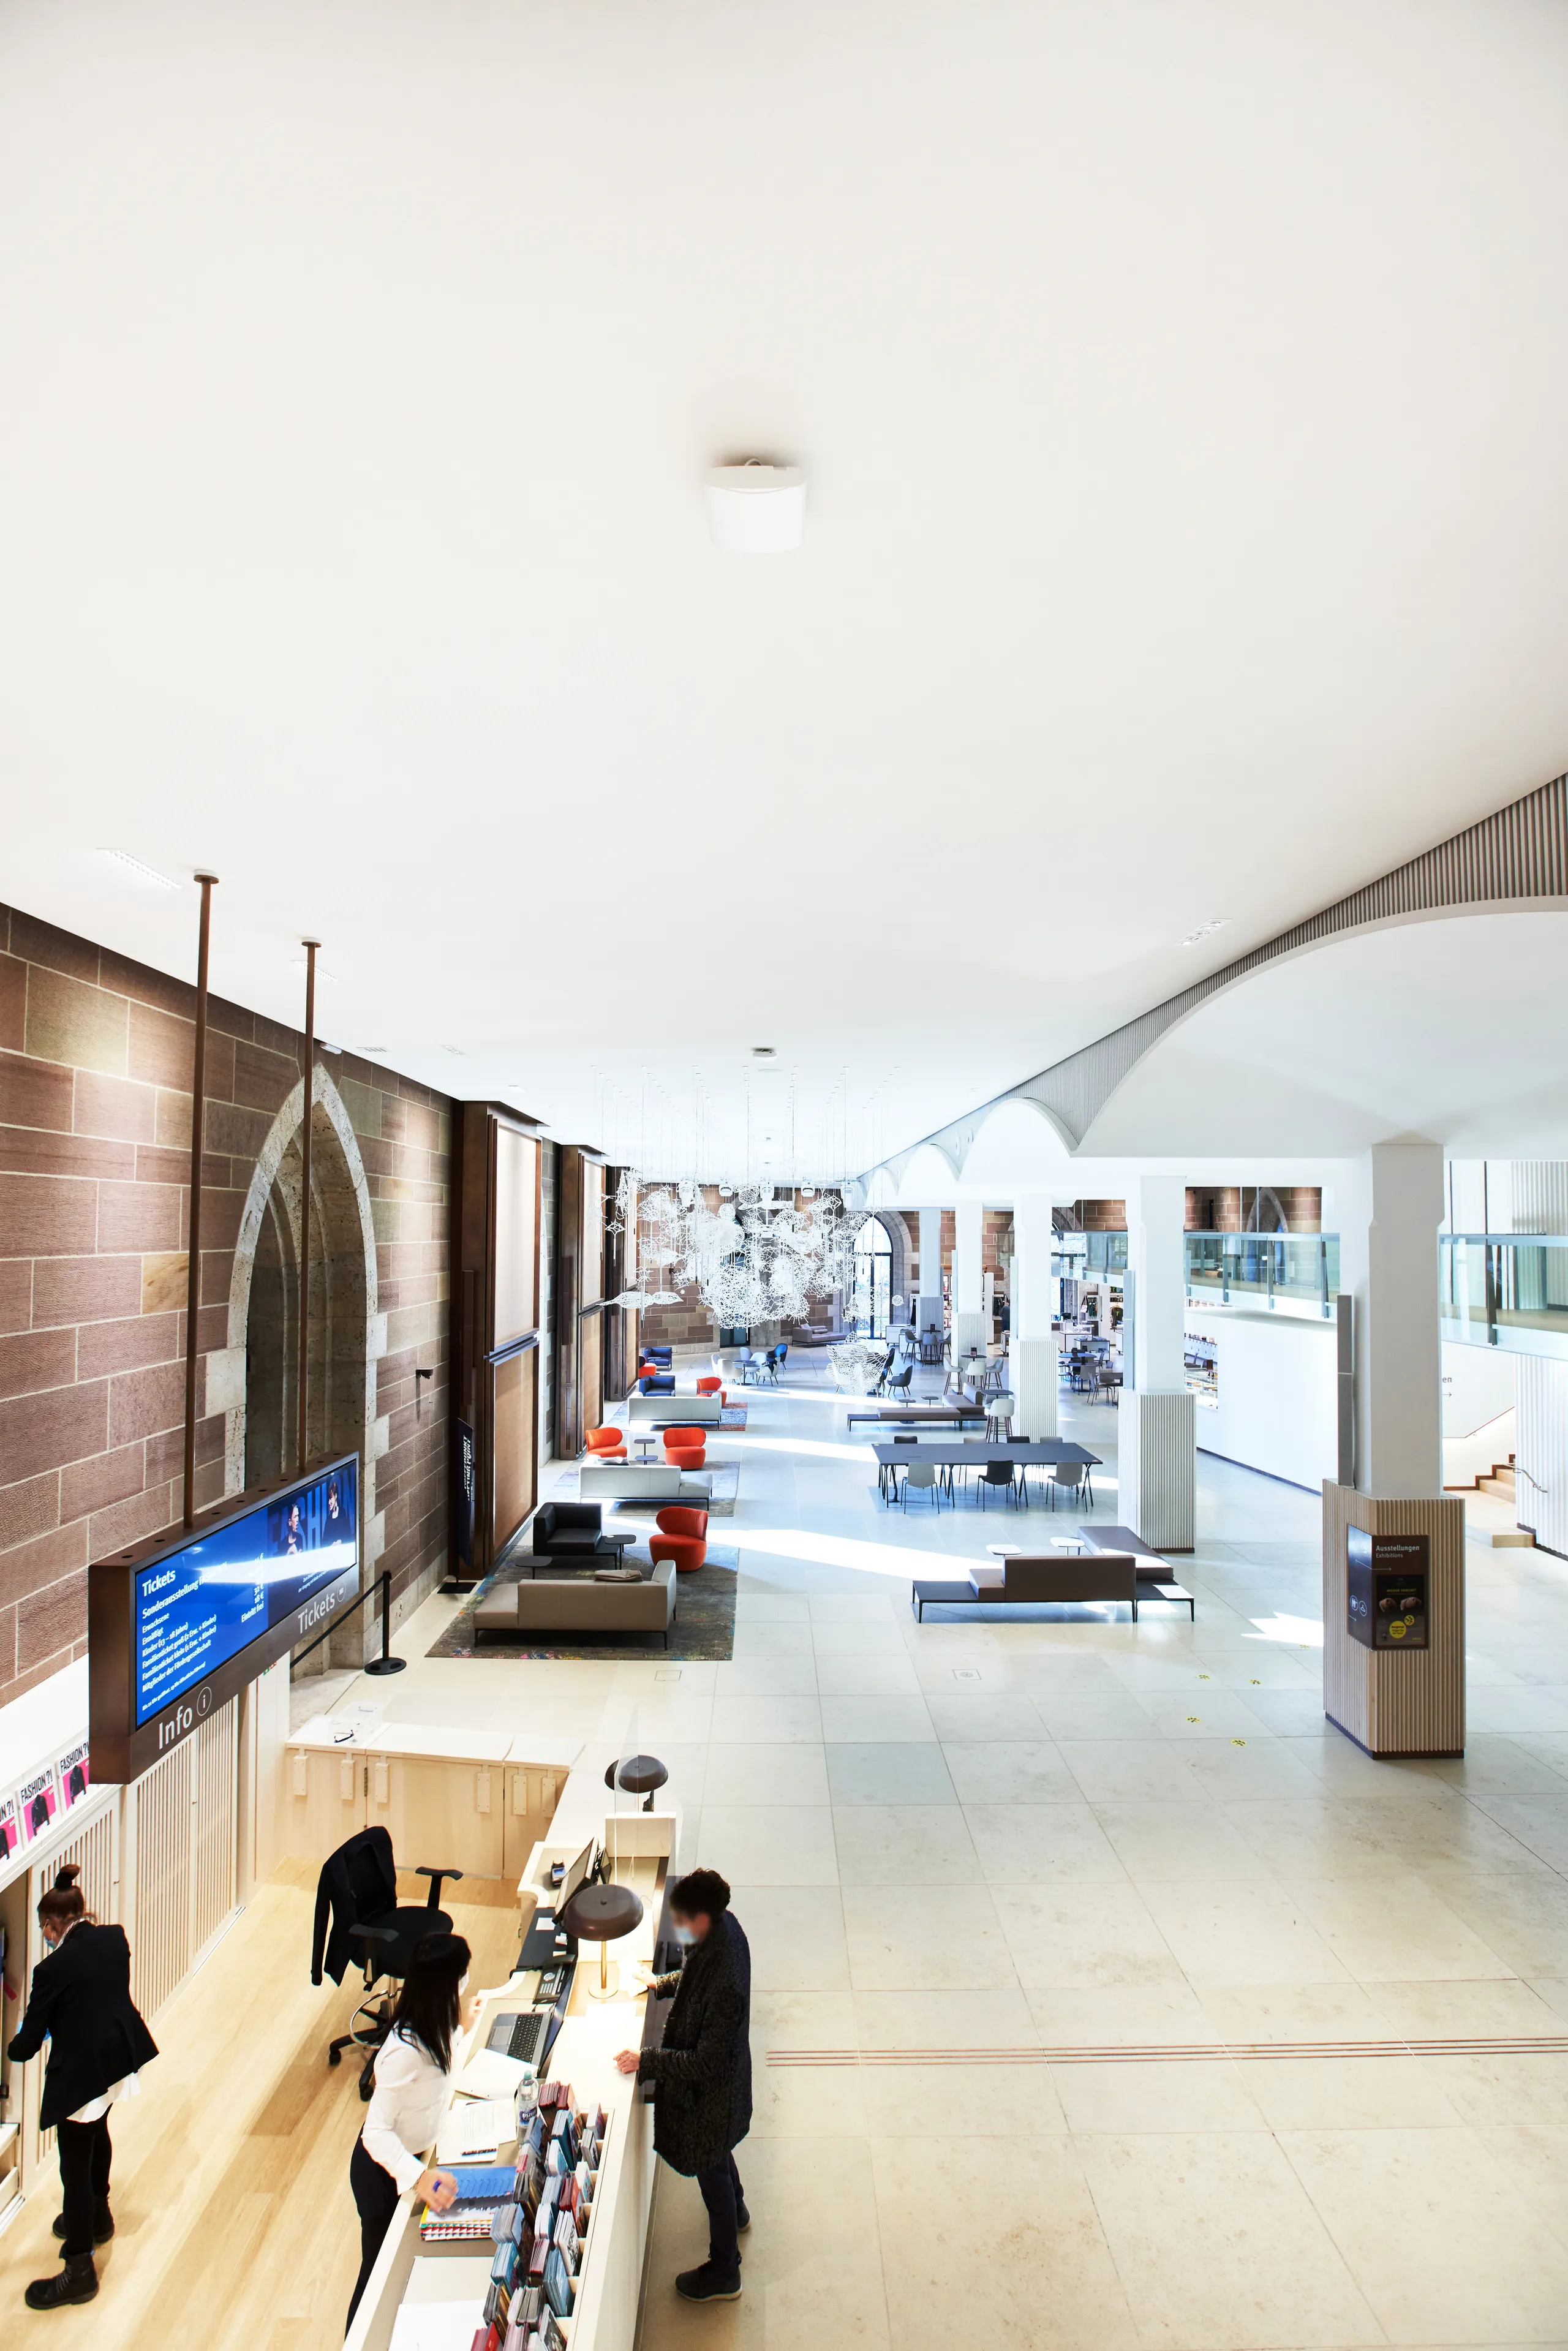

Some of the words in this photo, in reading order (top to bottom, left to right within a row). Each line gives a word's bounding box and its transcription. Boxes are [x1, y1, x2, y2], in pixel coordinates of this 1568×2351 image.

[142, 1570, 176, 1597] Tickets
[254, 1585, 260, 1596] 32
[254, 1594, 260, 1604] 18
[260, 1591, 264, 1599] €
[142, 1580, 199, 1619] Sonderausstellung
[298, 1593, 335, 1634] Tickets
[142, 1613, 170, 1634] Erwachsene
[241, 1606, 256, 1623] Eintritt
[142, 1627, 164, 1646] Ermäßigt
[142, 1643, 174, 1669] Familienticket
[174, 1638, 184, 1650] groß
[202, 1613, 217, 1629] Kinder)
[142, 1642, 158, 1658] Kinder
[142, 1655, 174, 1681] Familienticket
[174, 1647, 185, 1659] klein
[202, 1625, 217, 1640] Kinder)
[142, 1671, 166, 1693] Mitglieder
[174, 1639, 211, 1670] Fördergesellschaft
[159, 1705, 193, 1750] Info
[60, 1746, 83, 1774] FASHION
[21, 1773, 47, 1805] FASHION
[46, 1768, 53, 1784] ?!
